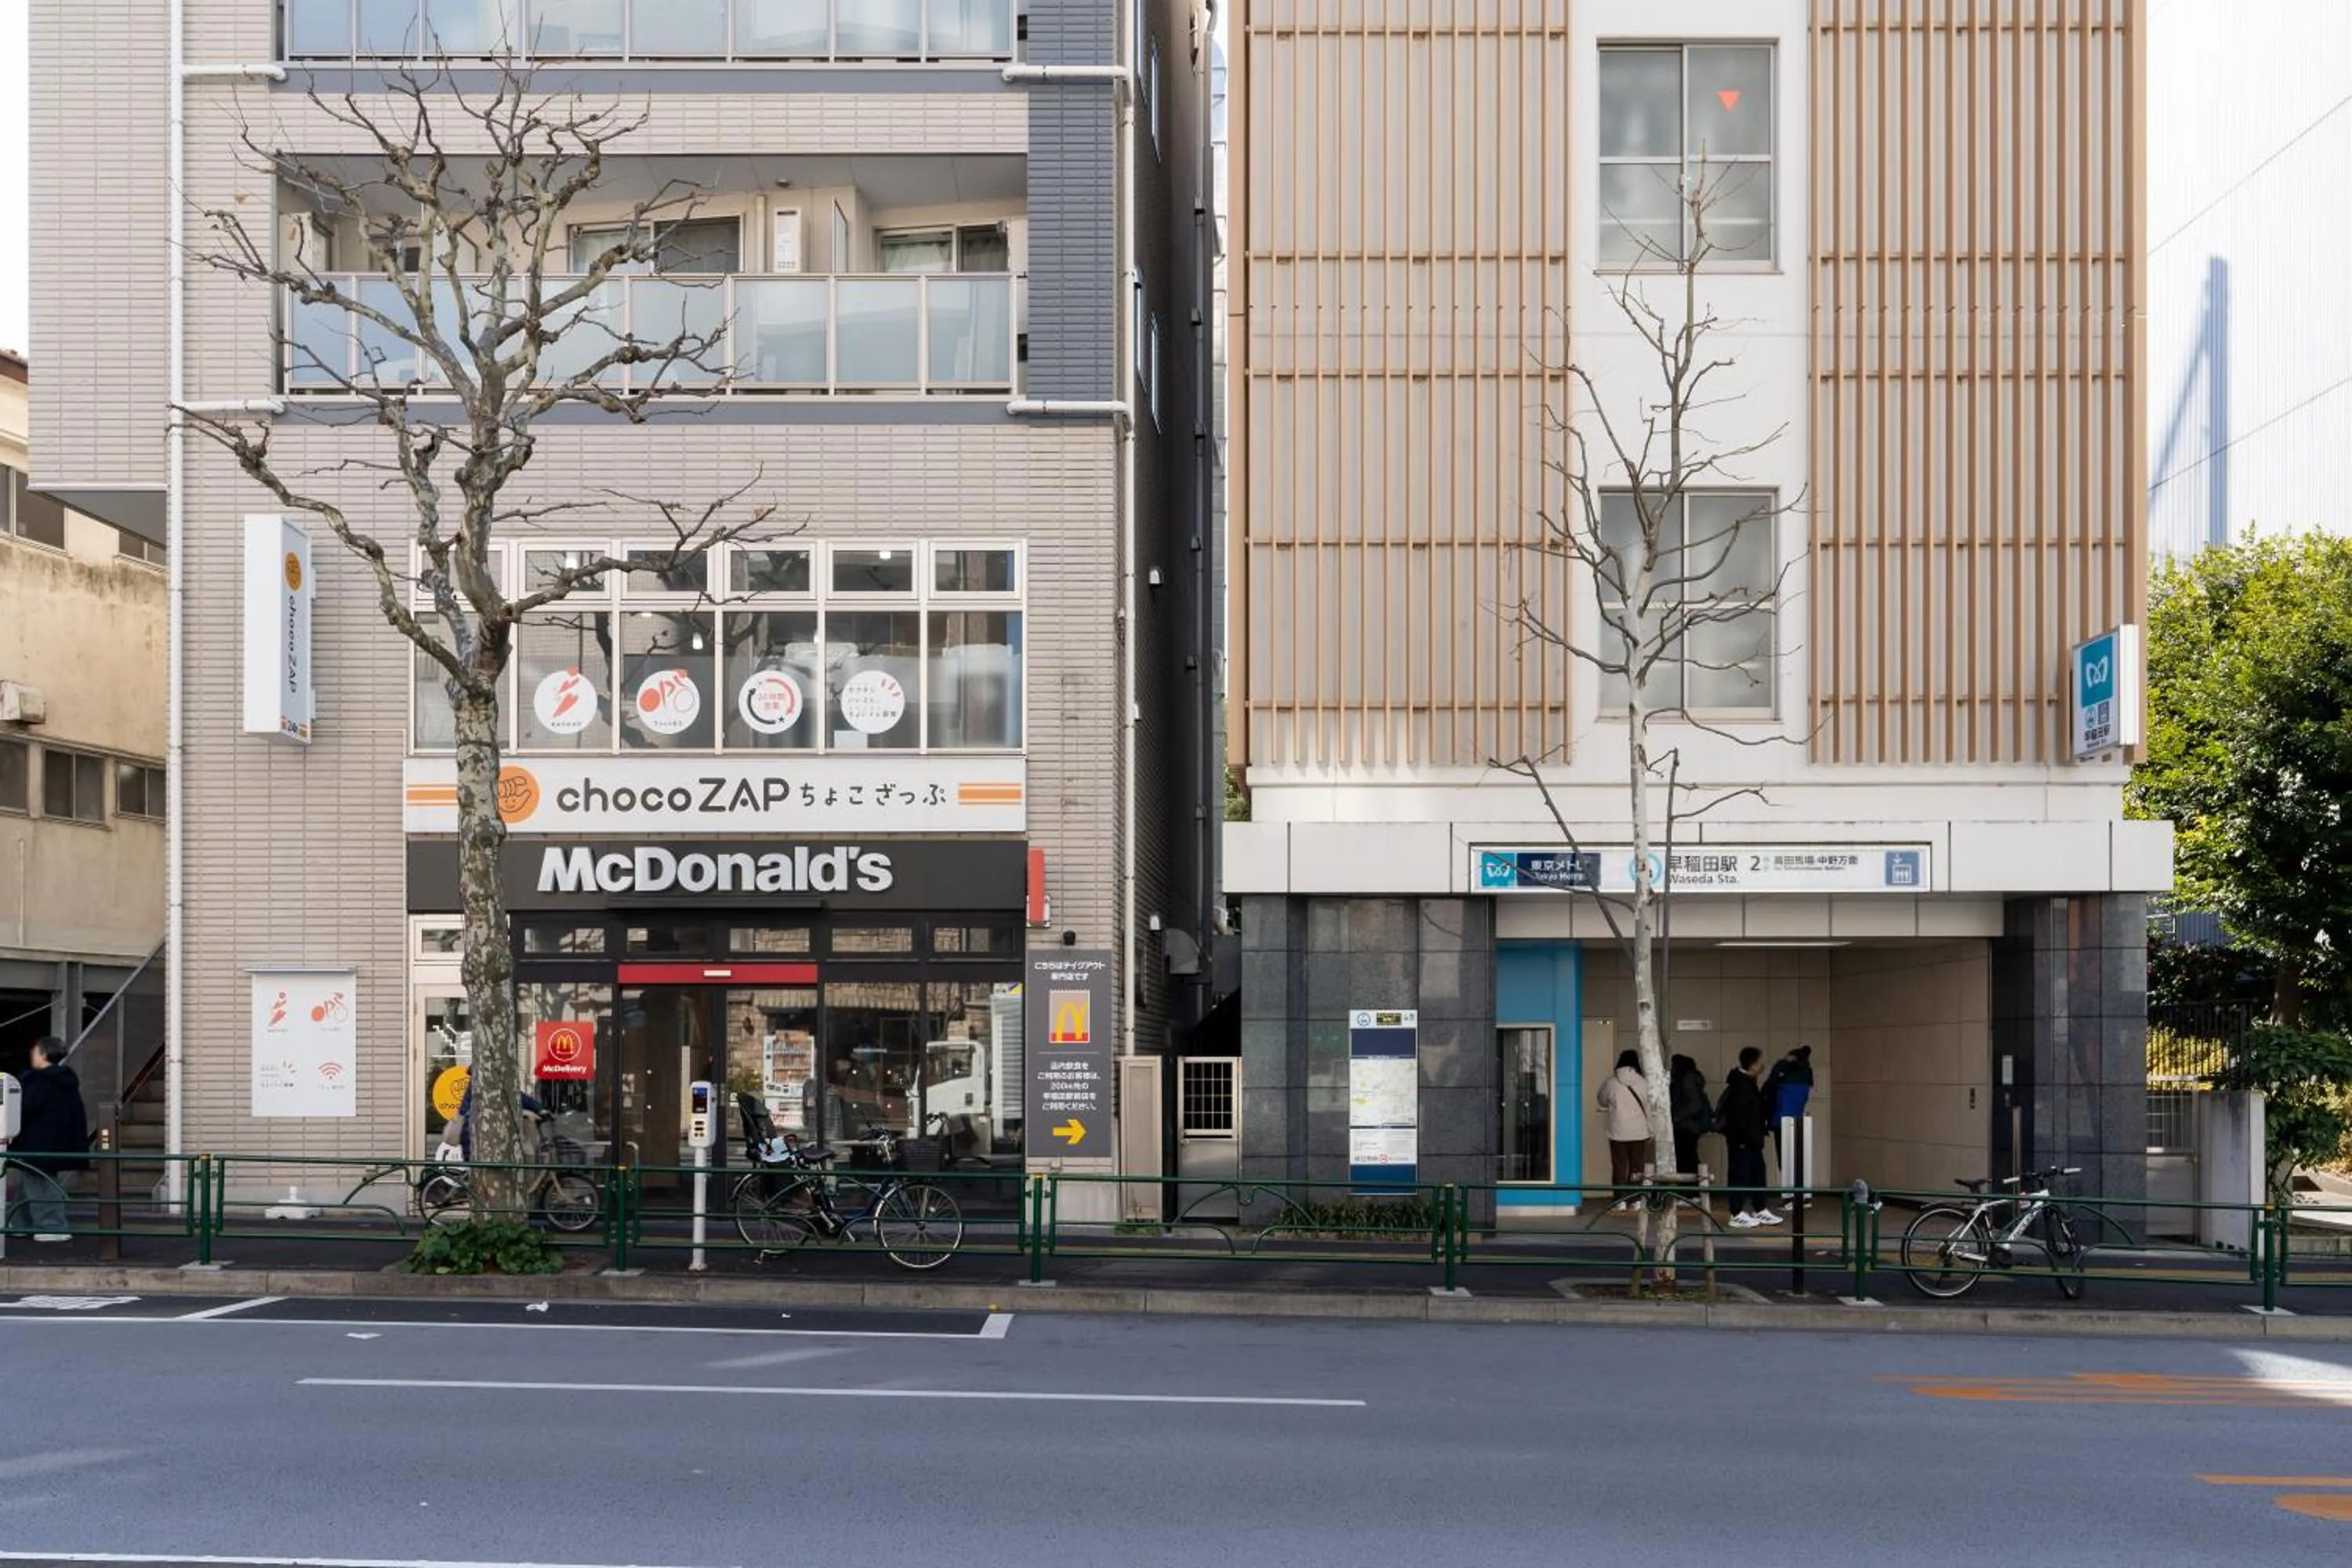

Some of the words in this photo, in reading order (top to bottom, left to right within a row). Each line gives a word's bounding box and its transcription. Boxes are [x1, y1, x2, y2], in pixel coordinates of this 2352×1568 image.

[556, 777, 789, 814] chocoZAP
[800, 782, 947, 807] ちょこざっぷ
[536, 845, 894, 892] McDonald's
[1668, 855, 1737, 872] 早稲田駅
[1750, 855, 1761, 871] 2
[1718, 873, 1740, 884] Sta.
[542, 1065, 587, 1074] McDelivery
